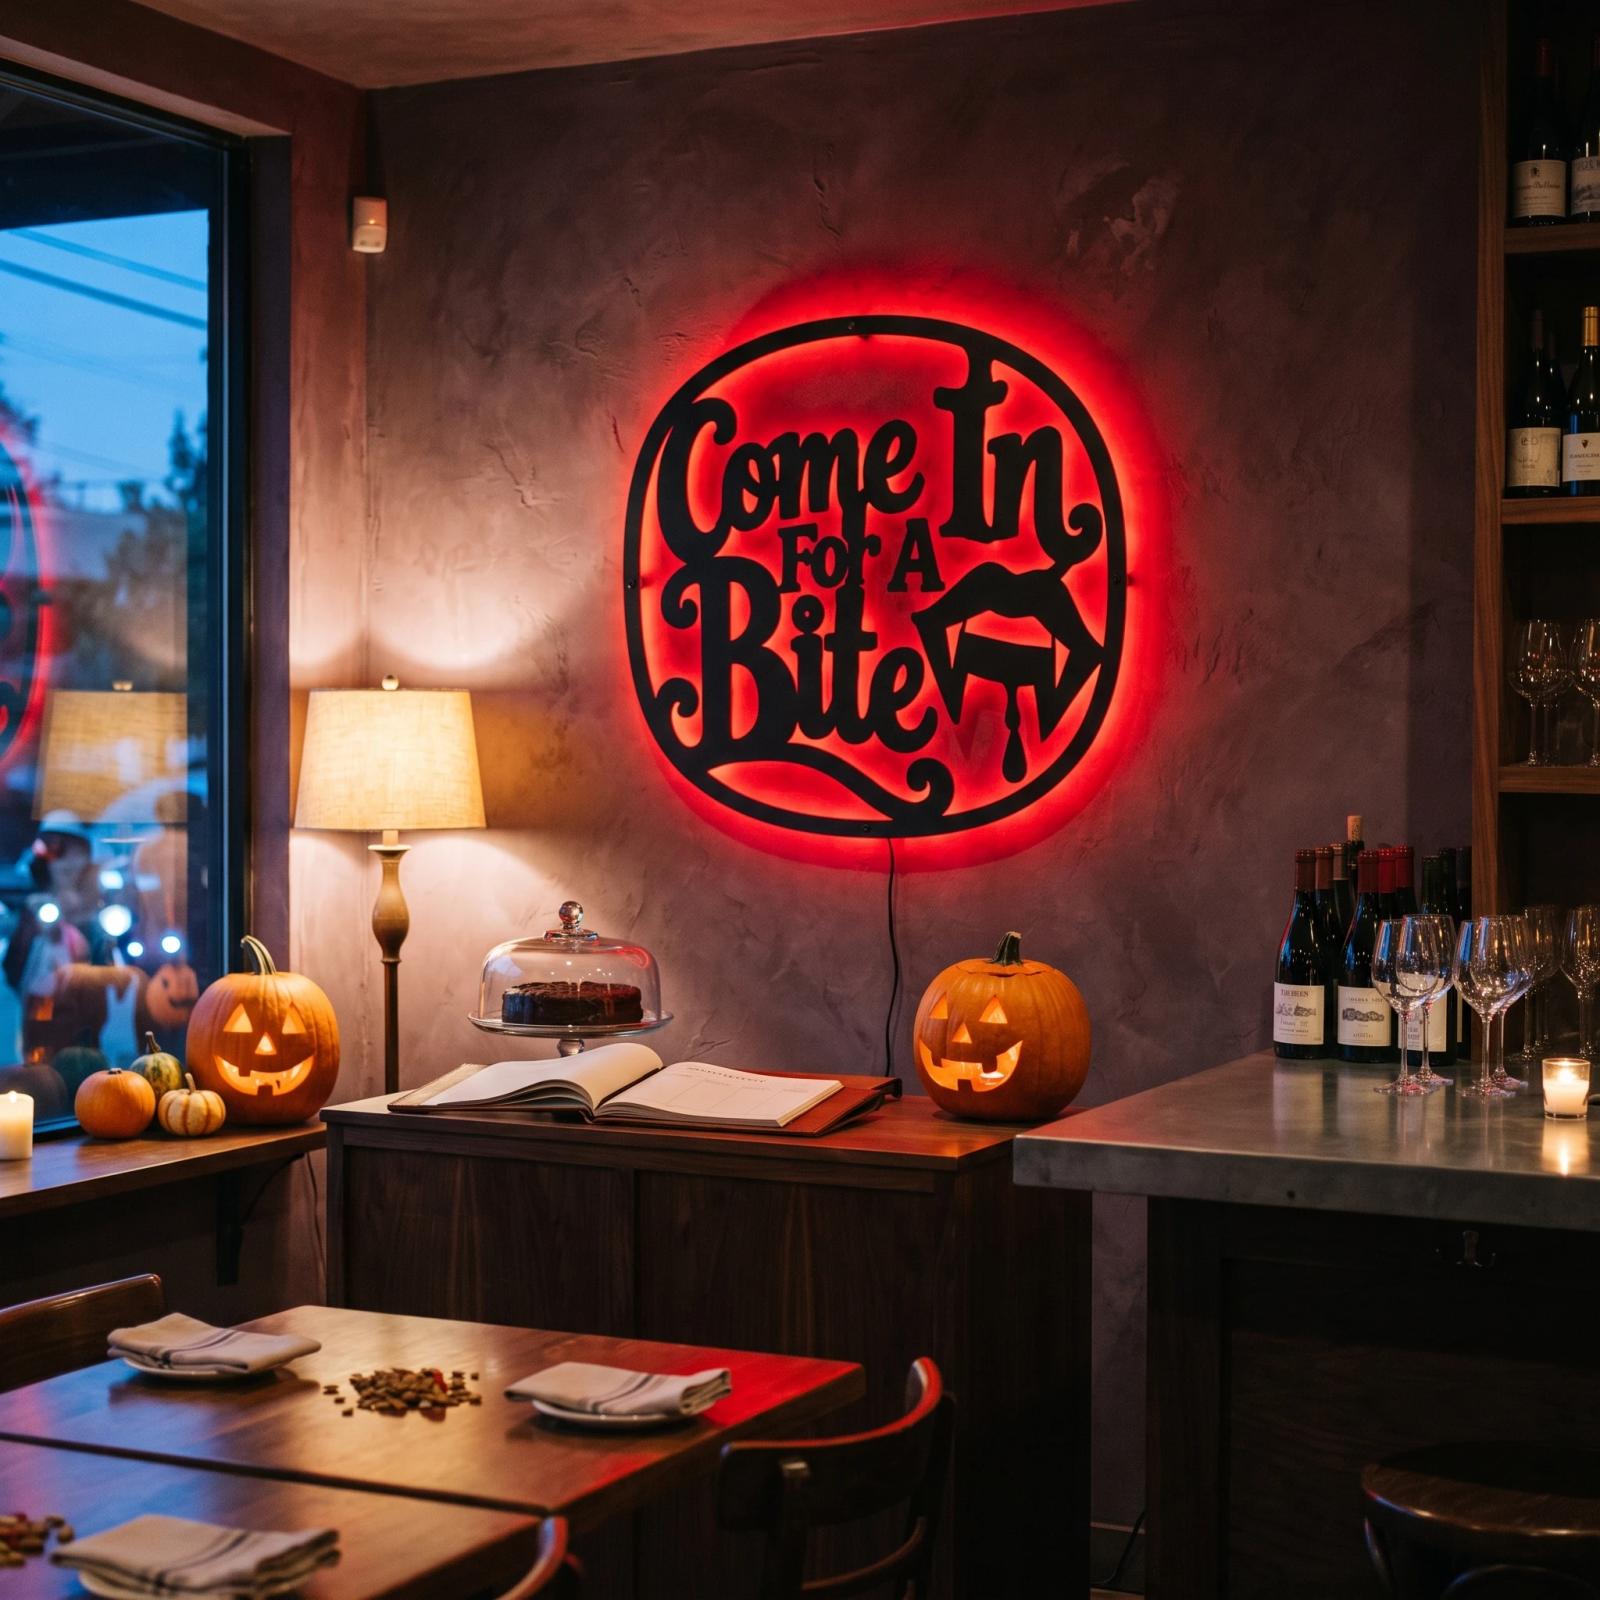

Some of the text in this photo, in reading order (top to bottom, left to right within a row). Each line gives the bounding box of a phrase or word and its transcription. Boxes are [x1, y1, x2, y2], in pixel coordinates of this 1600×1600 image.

[657, 360, 1103, 563] Come In
[778, 518, 945, 593] For A
[661, 556, 938, 762] Bite
